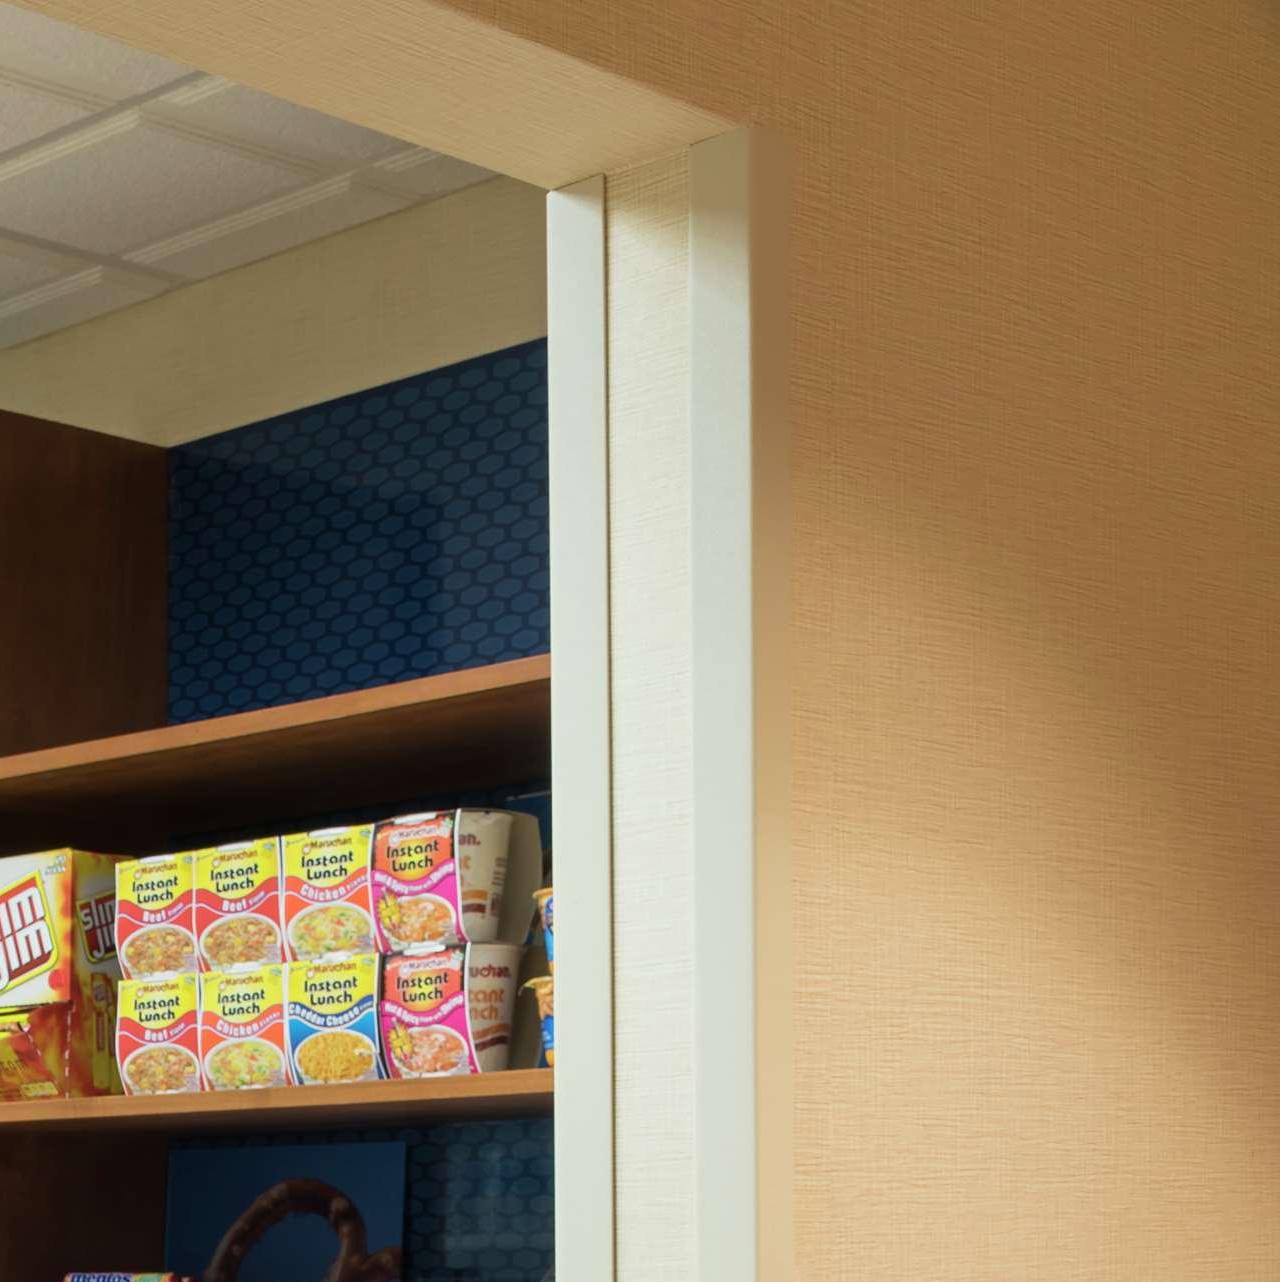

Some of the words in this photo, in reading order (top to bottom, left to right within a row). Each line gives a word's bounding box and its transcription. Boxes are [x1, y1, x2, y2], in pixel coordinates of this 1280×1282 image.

[386, 839, 440, 858] Instant
[301, 851, 354, 868] Instant
[392, 856, 434, 872] Lunch
[210, 864, 259, 881] Instant
[306, 866, 348, 881] Lunch
[132, 876, 178, 892] Instant
[216, 878, 255, 893] Lunch
[300, 883, 346, 901] Chicken
[137, 890, 174, 904] Lunch
[304, 976, 358, 992] Instant
[396, 972, 449, 990] Instant
[134, 996, 180, 1011] Instant
[217, 990, 266, 1004] Instant
[310, 991, 353, 1006] Lunch
[402, 988, 444, 1003] Lunch
[139, 1010, 176, 1023] Lunch
[222, 1003, 261, 1017] Lunch
[289, 1003, 326, 1027] Cheddar
[216, 1020, 259, 1037] Chicken
